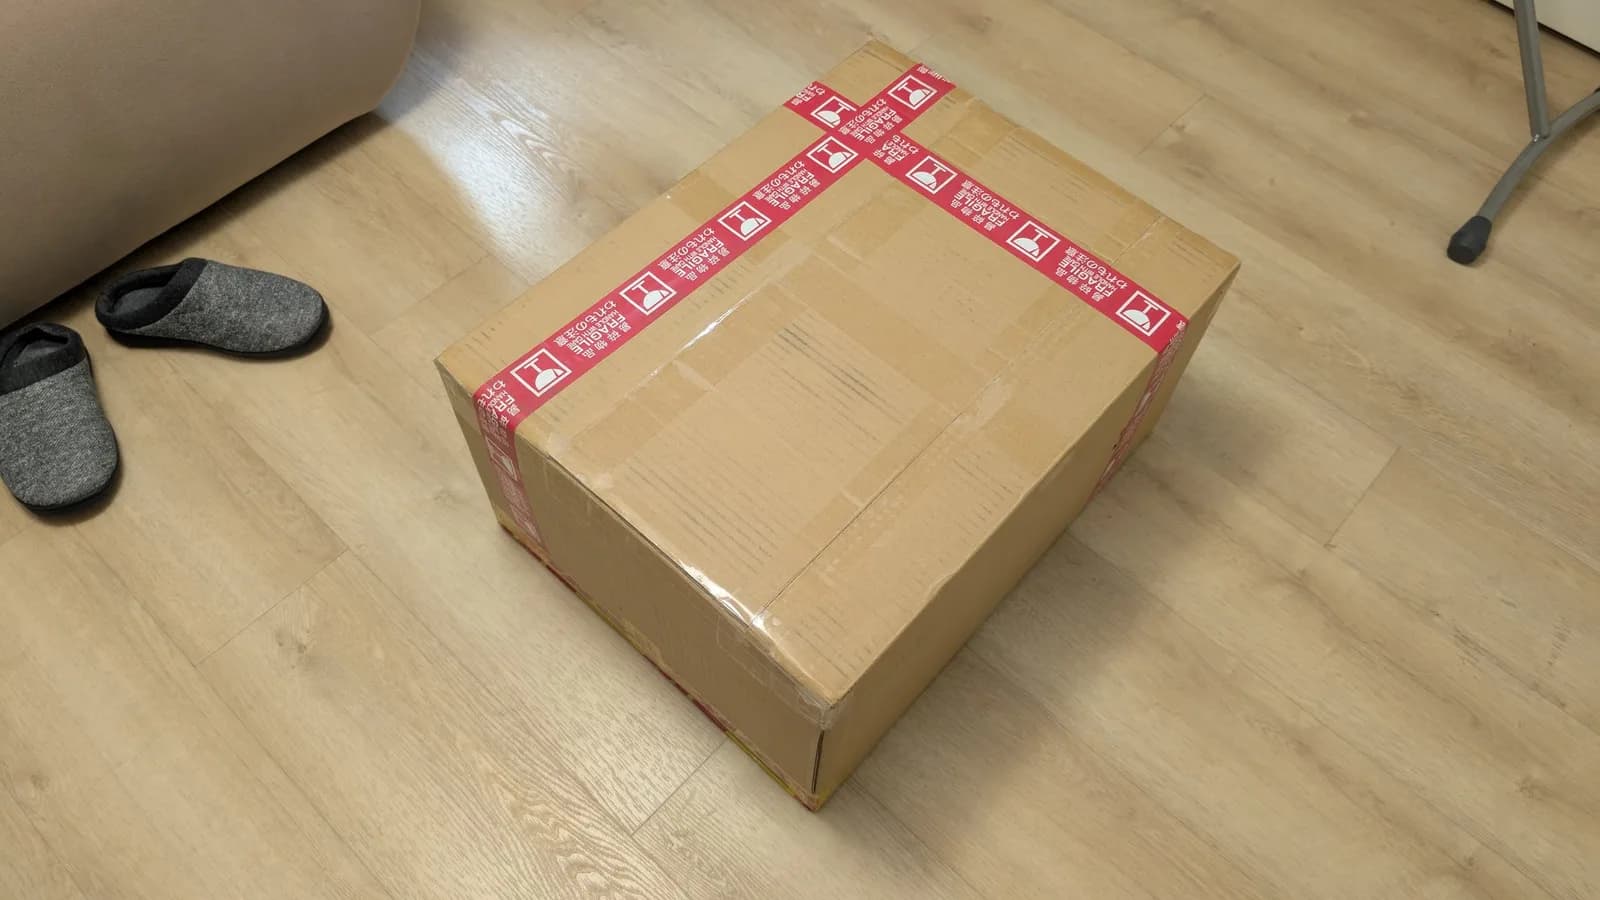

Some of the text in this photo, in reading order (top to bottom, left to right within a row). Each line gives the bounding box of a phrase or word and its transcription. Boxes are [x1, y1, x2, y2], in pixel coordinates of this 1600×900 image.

[854, 109, 896, 140] FRAGILE
[752, 160, 805, 199] われもの注意
[768, 172, 814, 206] FRAGILE
[954, 191, 1006, 226] FRAGILE
[962, 180, 1022, 219] われもの注意
[659, 227, 714, 269] われもの注意
[674, 239, 724, 277] FRAGILE
[685, 247, 730, 281] 易碎物品
[1055, 267, 1103, 301] 易碎物品
[1058, 258, 1114, 297] FRAGILE
[1066, 246, 1129, 289] われもの注意
[553, 299, 616, 345] われもの注意
[570, 313, 626, 354] FRAGILE
[582, 322, 631, 359] 易碎物品
